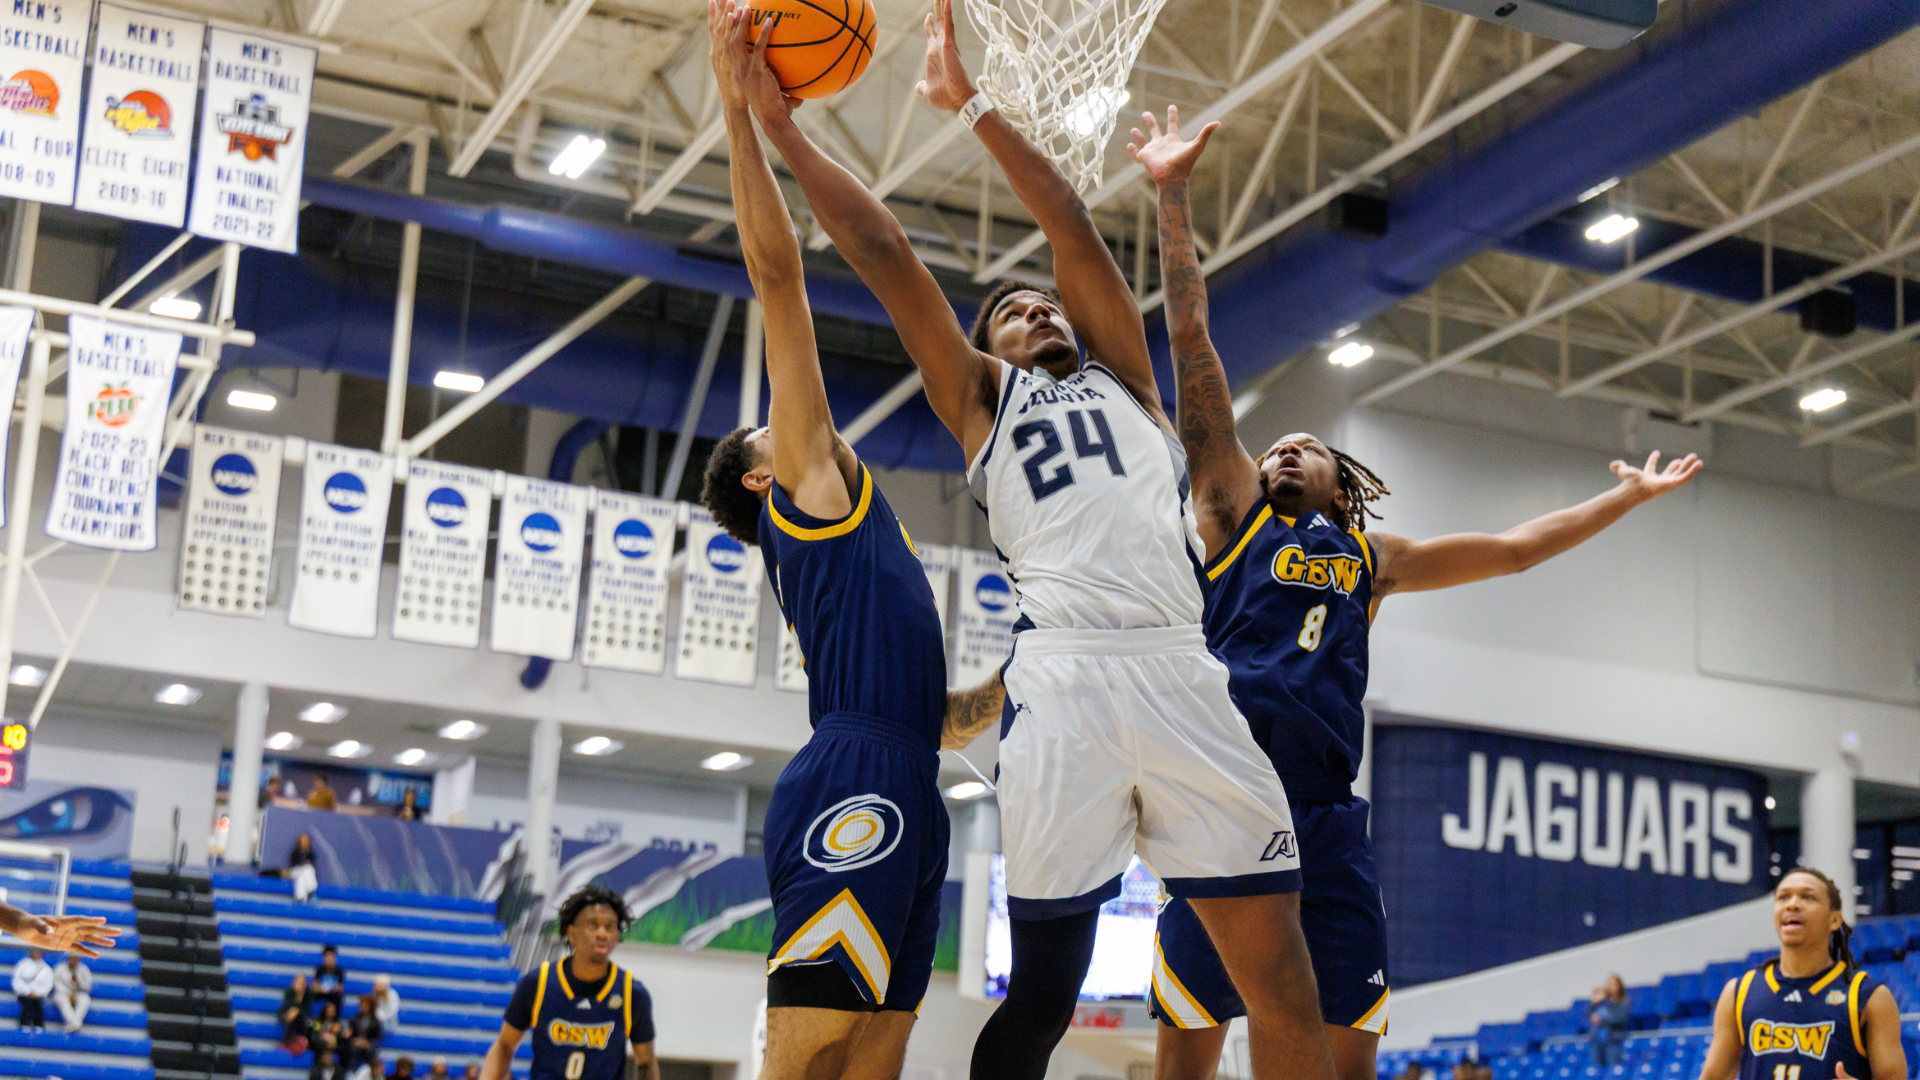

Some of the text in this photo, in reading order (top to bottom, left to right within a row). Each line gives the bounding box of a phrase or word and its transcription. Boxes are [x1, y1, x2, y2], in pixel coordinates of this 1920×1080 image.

[13, 0, 62, 24] MEN'S
[783, 12, 802, 20] NXT
[0, 27, 80, 60] SKETBALL
[127, 22, 176, 49] MEN'S
[99, 46, 194, 83] BASKETBALL
[241, 42, 283, 66] MEN'S
[215, 60, 302, 95] BASKETBALL
[34, 136, 75, 158] FOUR
[0, 163, 56, 188] 08-09
[85, 146, 187, 181] ELITE EIGHT
[215, 165, 281, 194] NATIONAL
[98, 181, 166, 209] 2009-10
[217, 190, 276, 217] FINALIST
[213, 214, 276, 240] 2021-22
[104, 331, 148, 351] MEN'S
[77, 347, 169, 378] BASKETBALL
[80, 431, 148, 457] 2022-23
[203, 433, 273, 452] MEN'S GOLF
[69, 447, 154, 476] PEACH BELT
[1010, 407, 1128, 505] 24
[65, 469, 150, 498] CONFERENCE
[66, 491, 144, 518] TOURNAMENT
[203, 499, 248, 514] DIVISION
[60, 513, 147, 542] CHAMPIONS
[193, 512, 268, 532] CHAMPIONSHIP
[334, 521, 373, 535] DIVISION
[192, 529, 267, 547] APPEARANCES
[306, 533, 378, 551] CHAMPIONSHIP
[436, 533, 470, 548] DIVISION
[410, 545, 479, 563] CHAMPIONSHIP
[532, 557, 564, 570] DIVISION
[505, 567, 573, 584] CHAMPIONSHIP
[599, 575, 667, 593] CHAMPIONSHIP
[623, 565, 656, 578] DIVISION
[1271, 544, 1363, 598] GSW
[691, 588, 759, 606] CHAMPIONSHIP
[715, 578, 747, 591] DIVISION
[1298, 604, 1327, 652] 8
[3, 724, 27, 750] 10
[1441, 751, 1753, 885] JAGUARS
[548, 1018, 616, 1051] GSW
[1749, 1018, 1836, 1061] GSW
[564, 1051, 586, 1080] 0
